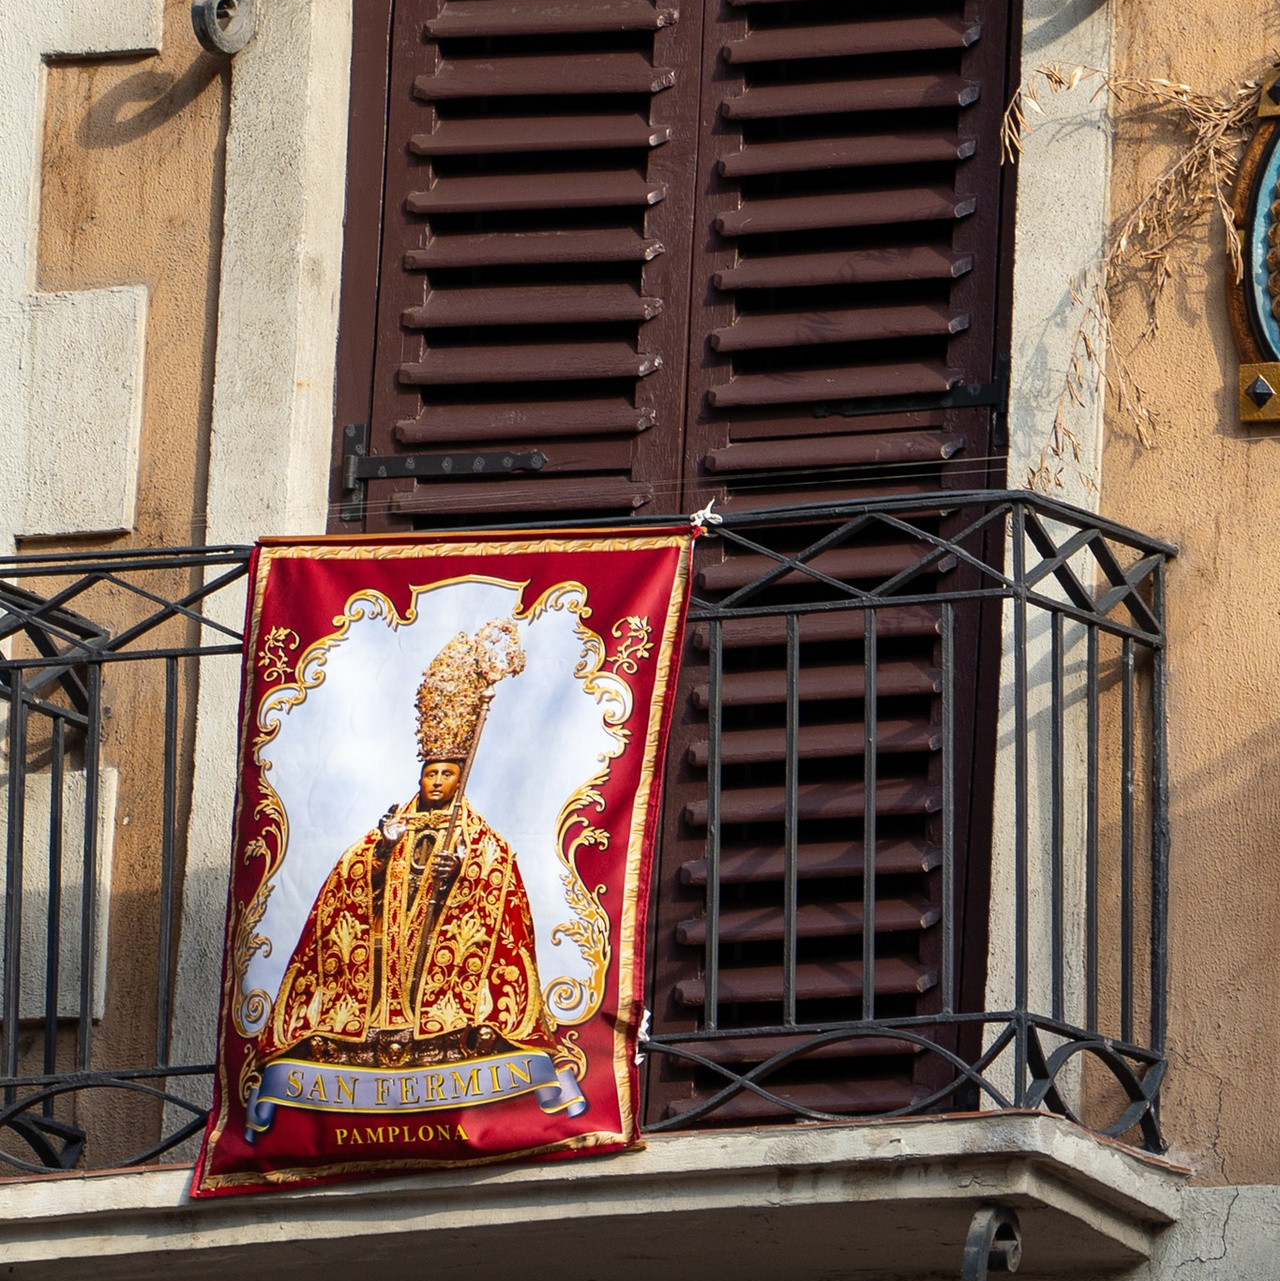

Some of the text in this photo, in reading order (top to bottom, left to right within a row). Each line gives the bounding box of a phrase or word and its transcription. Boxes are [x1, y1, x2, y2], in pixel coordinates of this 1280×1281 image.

[285, 1058, 534, 1106] SAN FERMIN
[335, 1123, 470, 1145] PAMPLONA
